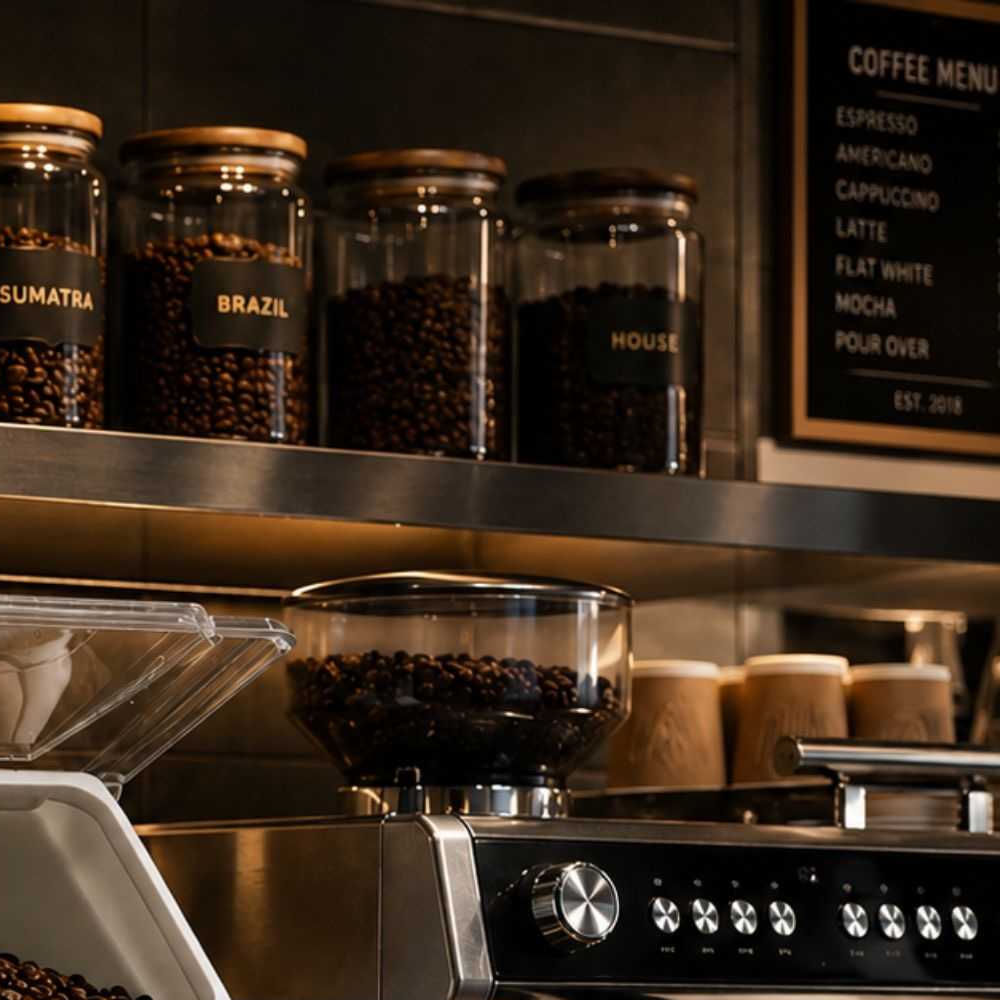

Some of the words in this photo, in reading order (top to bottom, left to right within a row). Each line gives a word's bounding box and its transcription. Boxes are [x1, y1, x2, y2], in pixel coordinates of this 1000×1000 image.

[847, 44, 931, 86] COFFEE
[936, 56, 999, 96] MENU
[835, 104, 919, 136] ESPRESSO
[835, 142, 934, 176] AMERICANO
[834, 178, 941, 213] CAPPUCCINO
[834, 215, 889, 244] LATTE
[834, 253, 877, 280] FLAT
[879, 258, 936, 288] WHITE
[0, 284, 94, 311] SUMATRA
[217, 293, 289, 319] BRAZIL
[834, 291, 898, 320] MOCHA
[610, 329, 680, 354] HOUSE
[834, 329, 883, 356] POUR
[885, 333, 931, 361] OVER
[893, 388, 926, 414] EST.
